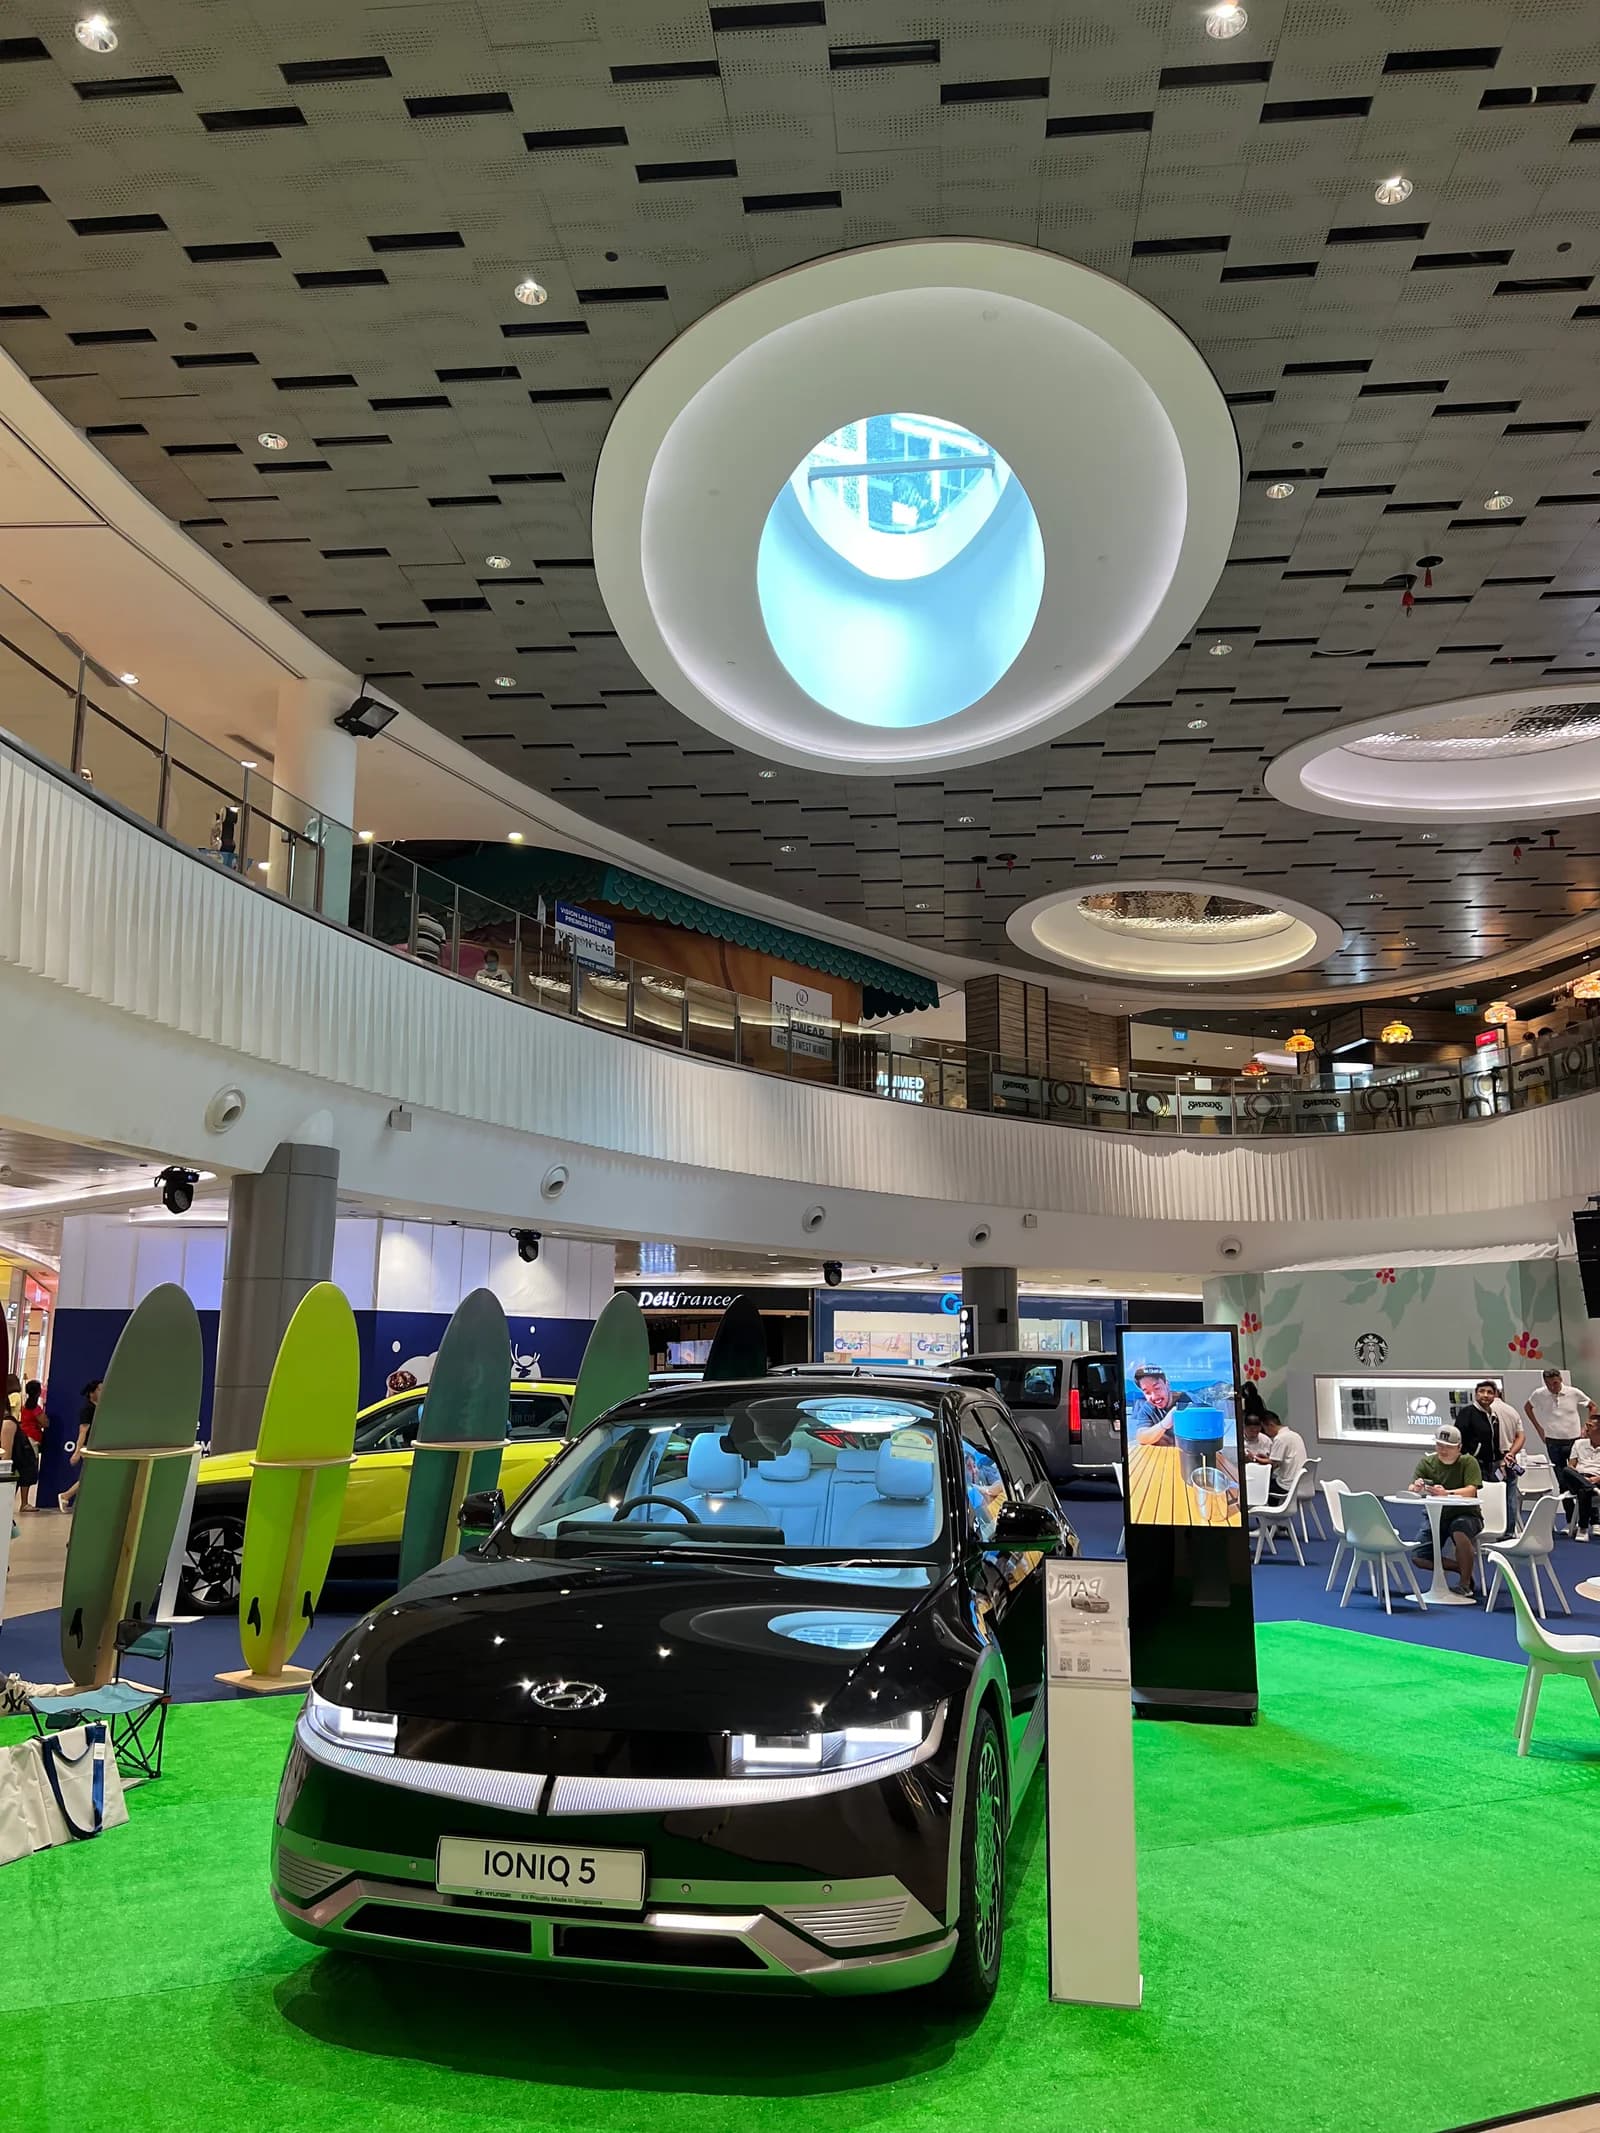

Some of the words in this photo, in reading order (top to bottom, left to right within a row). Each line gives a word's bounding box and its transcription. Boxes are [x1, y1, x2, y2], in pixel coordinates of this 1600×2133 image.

[638, 1291, 731, 1308] Délifrance
[484, 1849, 570, 1887] IONIQ
[578, 1857, 596, 1884] 5
[574, 1898, 603, 1906] Singapore
